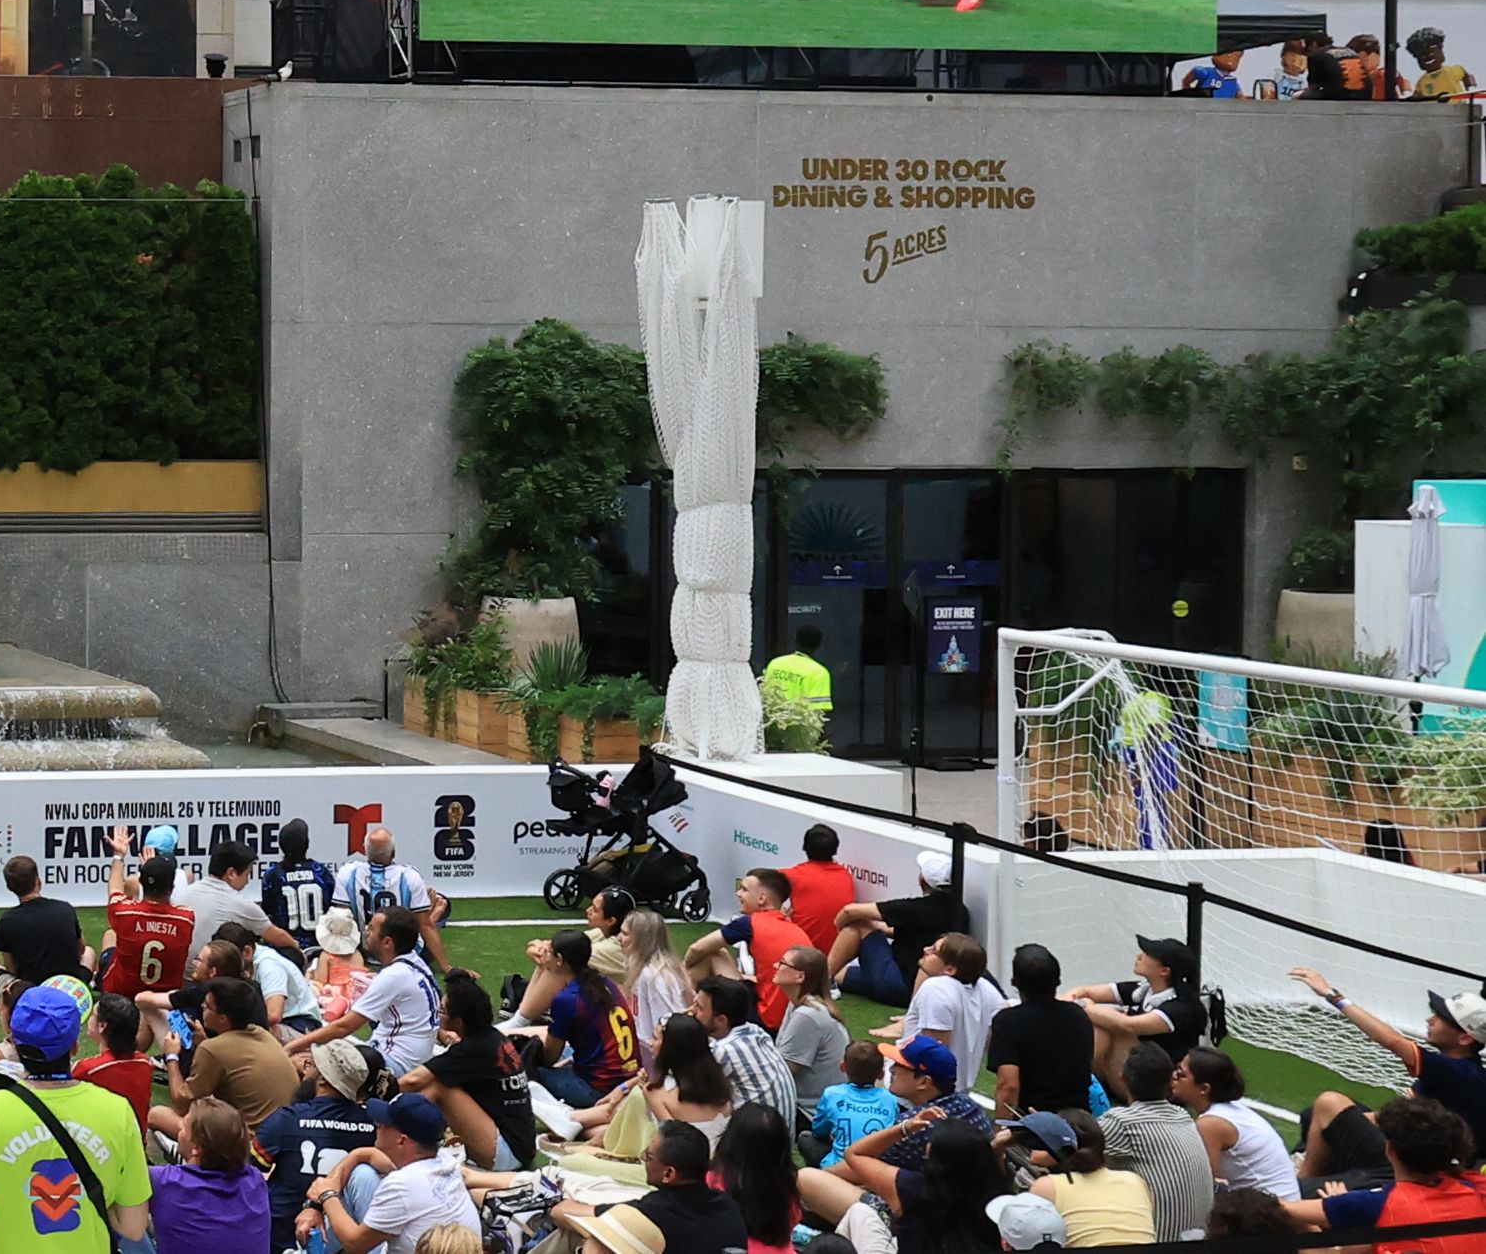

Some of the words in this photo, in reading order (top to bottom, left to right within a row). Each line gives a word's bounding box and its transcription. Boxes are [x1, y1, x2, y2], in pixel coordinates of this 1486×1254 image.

[802, 158, 889, 181] UNDER
[895, 159, 929, 182] 30
[935, 159, 1007, 182] ROCK
[773, 185, 867, 208] DINING
[873, 186, 894, 209] &
[899, 186, 1036, 210] SHOPPING
[862, 230, 889, 284] 5
[893, 224, 947, 259] ACRES
[934, 607, 953, 619] EXIT
[953, 607, 975, 619] HERE
[772, 669, 806, 684] SECURITY
[45, 804, 78, 821] NYNJ
[82, 803, 115, 820] COPA
[118, 802, 175, 819] MUNDIAL
[178, 802, 194, 818] 26
[197, 801, 205, 818] Y
[208, 800, 281, 818] TELEMUNDO
[445, 847, 464, 856] FIFA
[519, 847, 566, 856] STREAMING
[734, 829, 779, 855] Hisense
[45, 865, 68, 884] EN
[286, 871, 314, 881] MESSI
[452, 863, 475, 871] YORK
[281, 882, 324, 932] 10
[135, 921, 145, 933] A.
[146, 921, 178, 937] INIESTA
[140, 940, 162, 985] 6
[609, 1005, 633, 1061] 6
[299, 1119, 323, 1129] FIFA
[325, 1120, 357, 1132] WORLD
[358, 1122, 374, 1133] CUP
[0, 1121, 111, 1166] VOLUTEER
